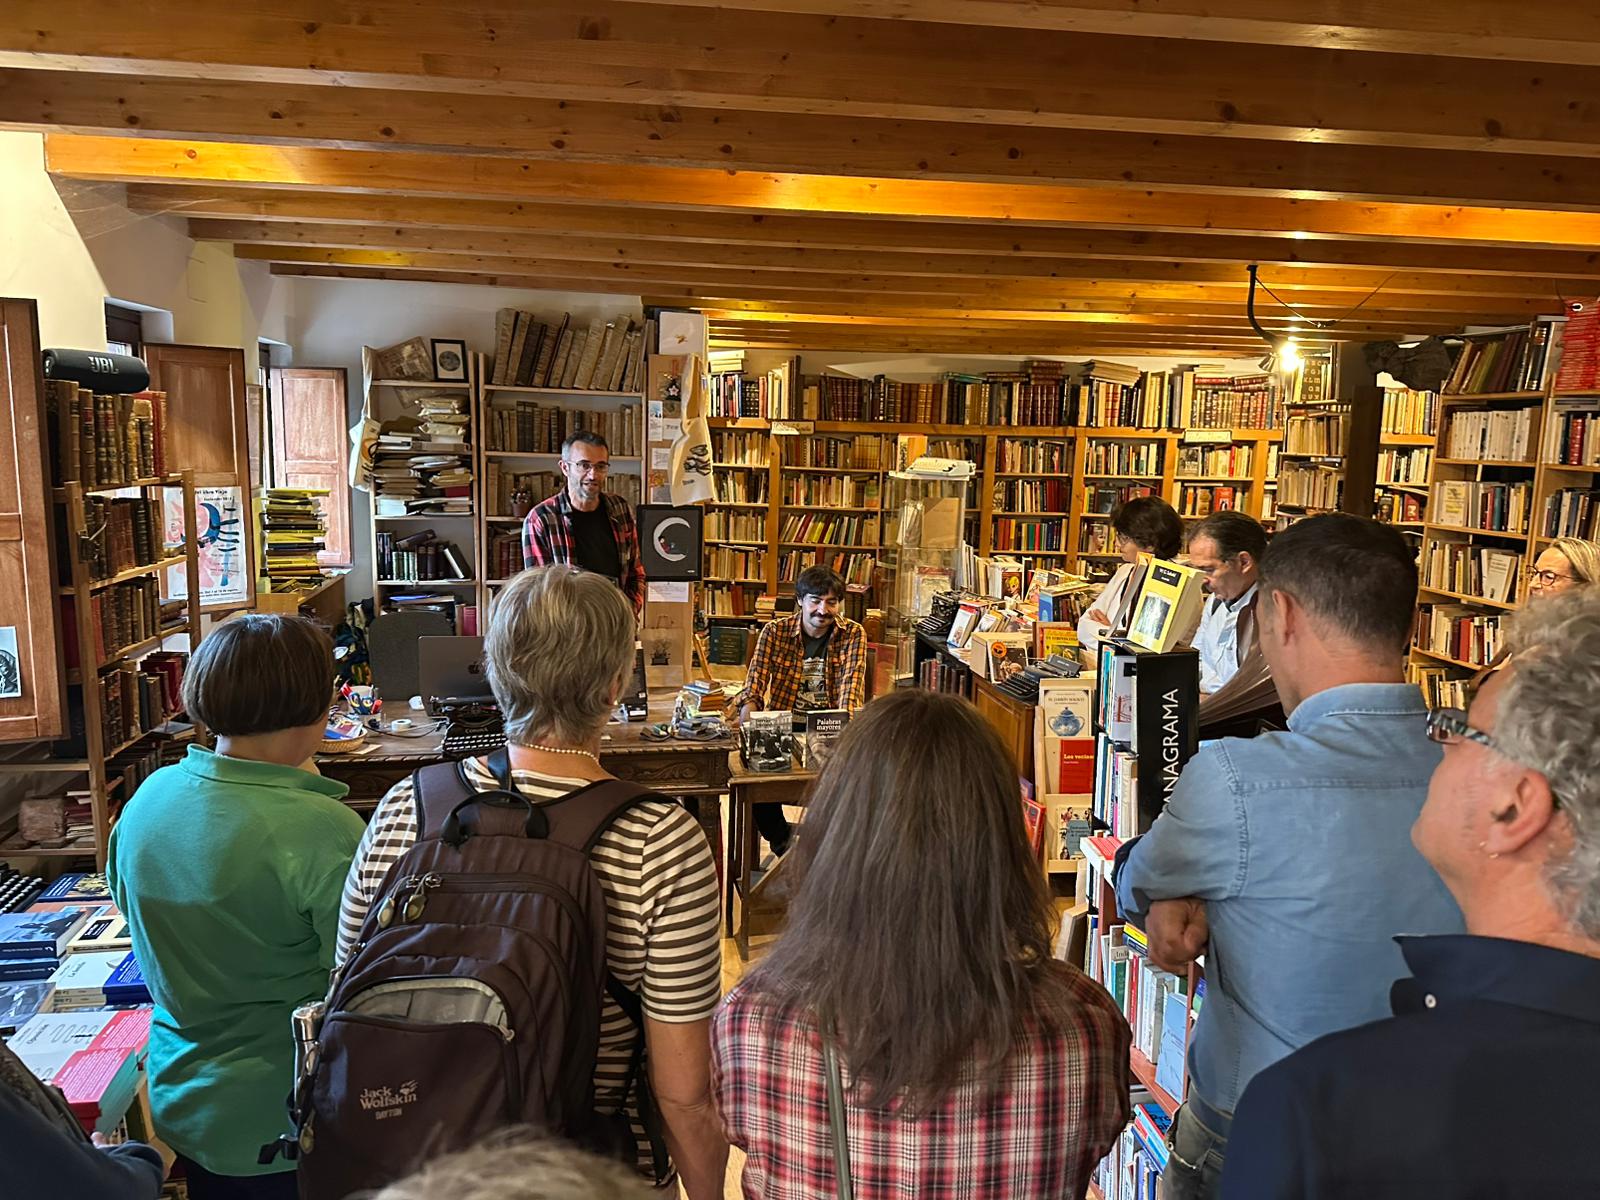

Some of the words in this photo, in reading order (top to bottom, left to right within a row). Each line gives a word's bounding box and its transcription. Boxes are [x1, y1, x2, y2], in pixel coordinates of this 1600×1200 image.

[88, 356, 119, 375] JBL
[360, 1086, 392, 1098] Jack
[360, 1093, 417, 1110] Wolfskin
